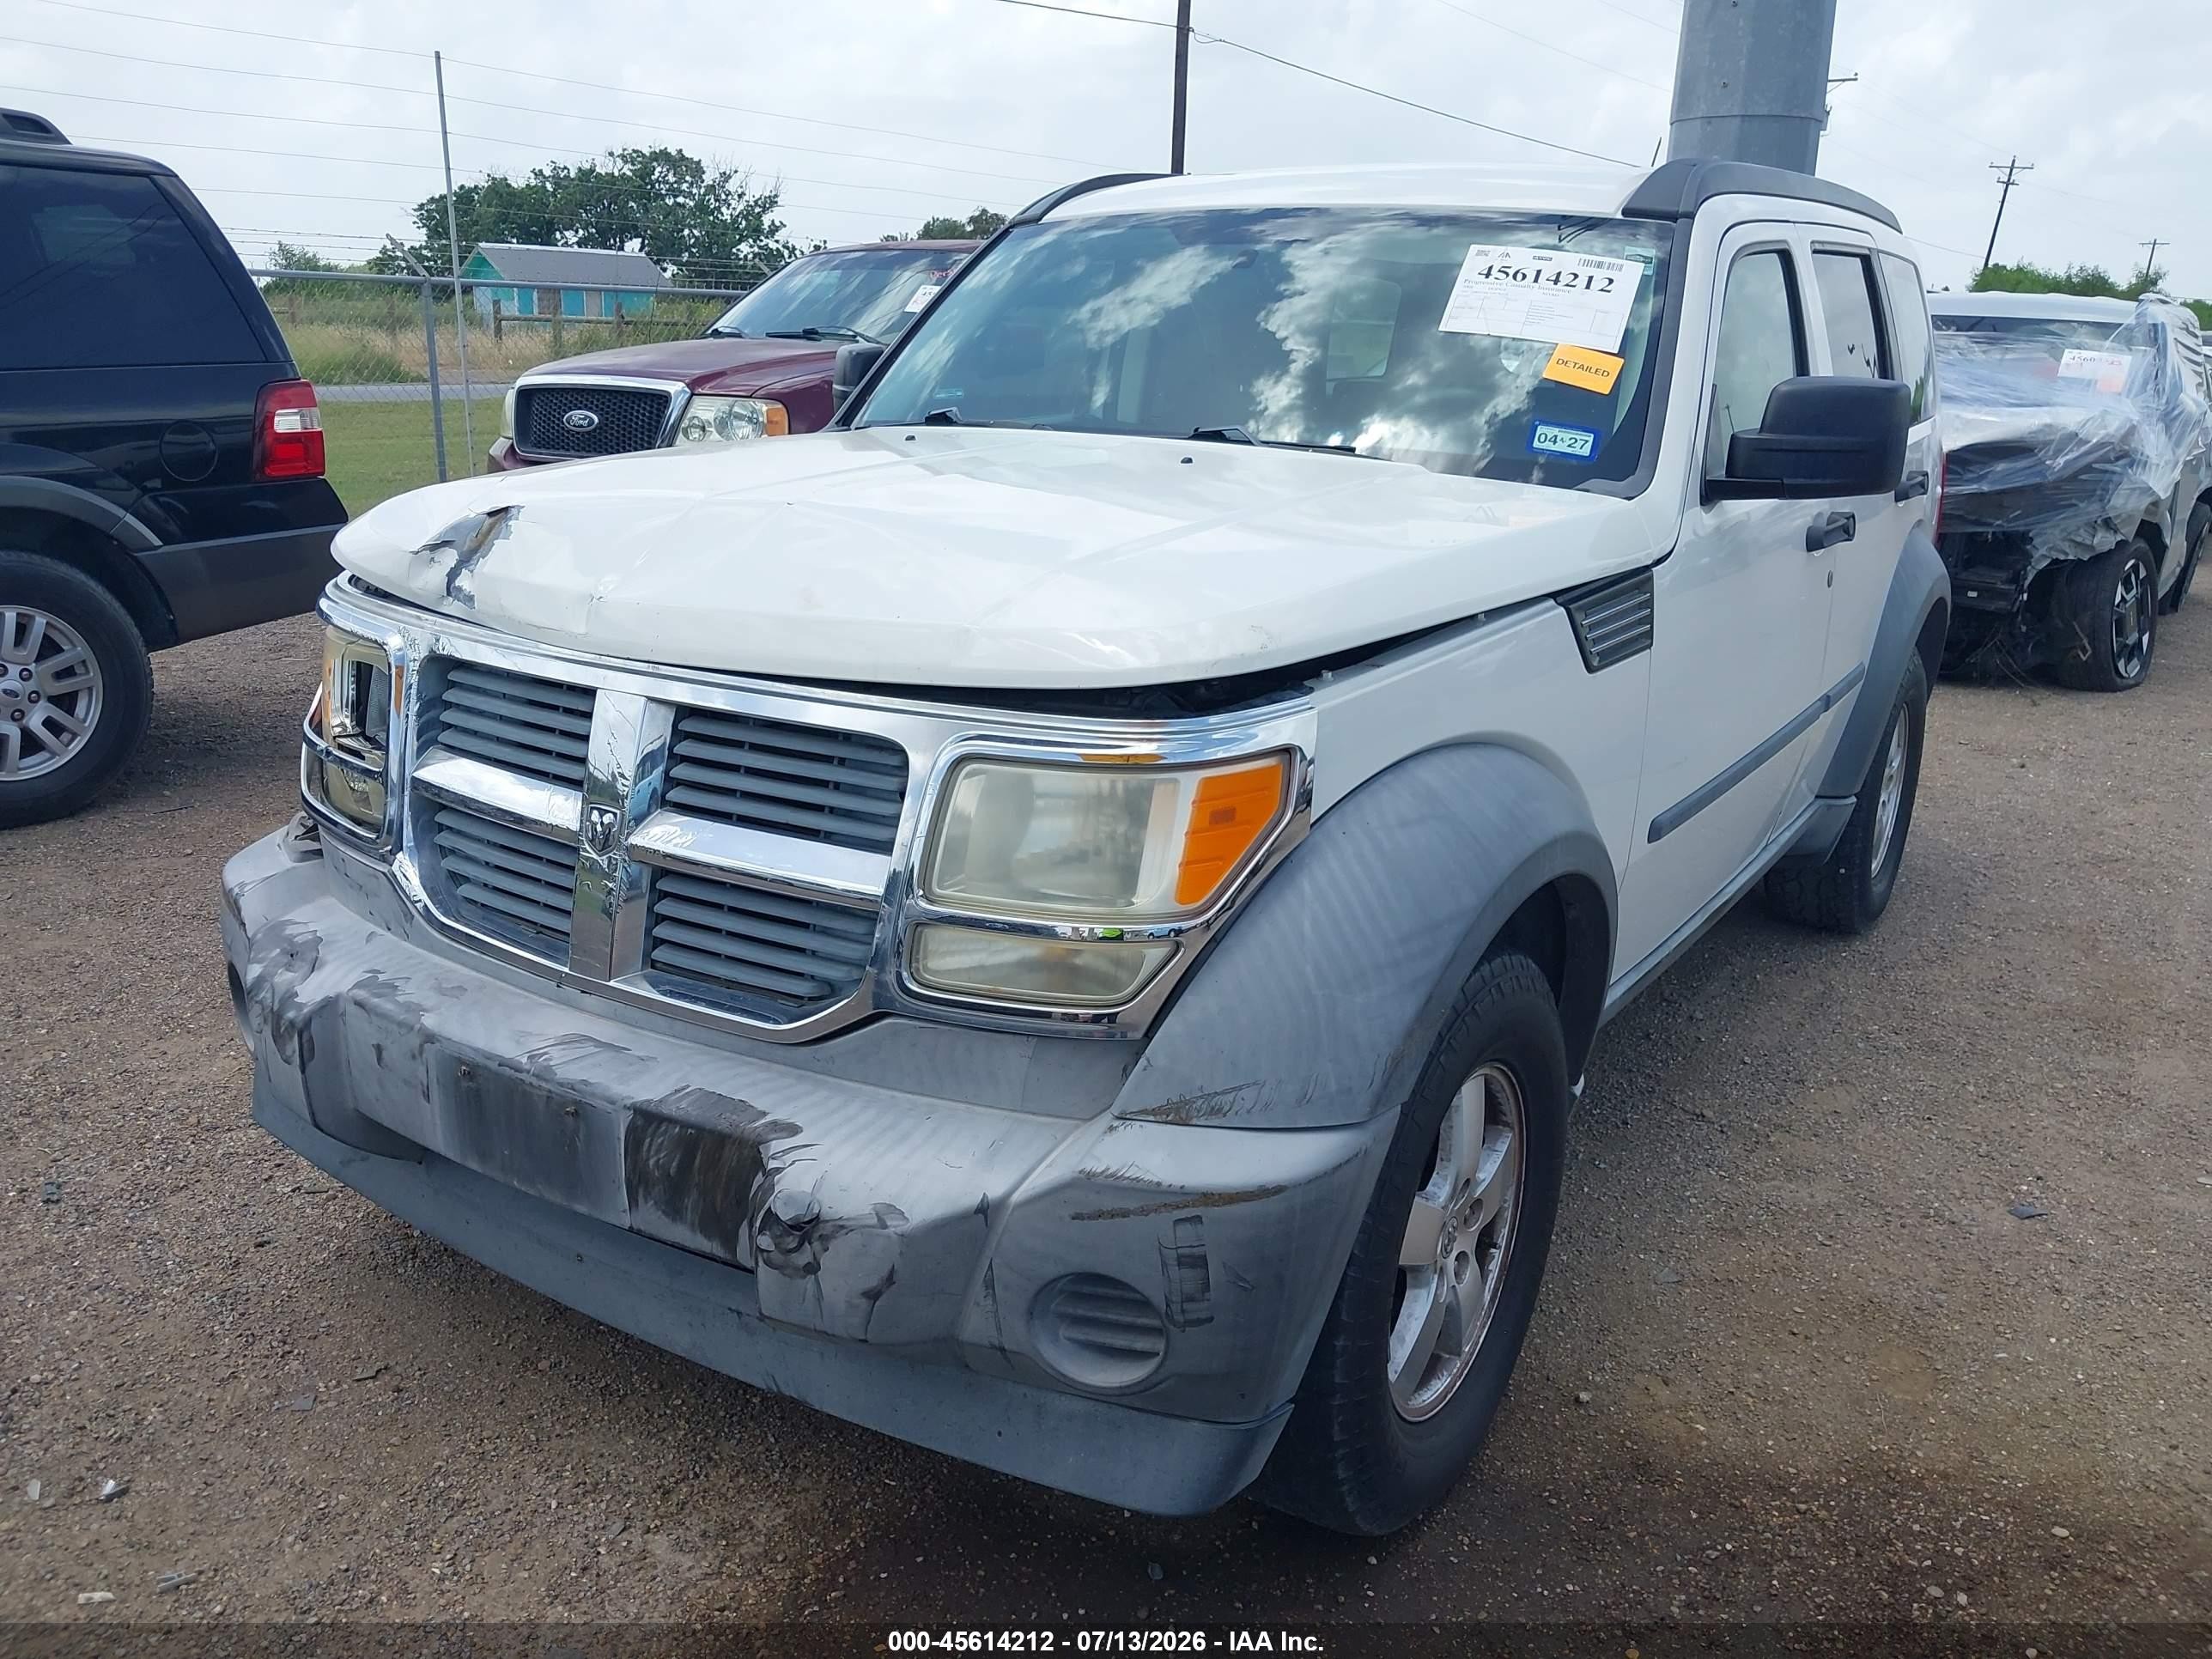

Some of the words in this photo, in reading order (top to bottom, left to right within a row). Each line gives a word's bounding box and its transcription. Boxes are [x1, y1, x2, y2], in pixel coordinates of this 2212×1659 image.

[1477, 264, 1615, 294] 45614212
[1537, 284, 1572, 295] Insurance
[1556, 357, 1610, 378] DETAILED
[569, 414, 590, 427] Ford
[1537, 432, 1559, 446] 04
[1566, 437, 1589, 450] 27
